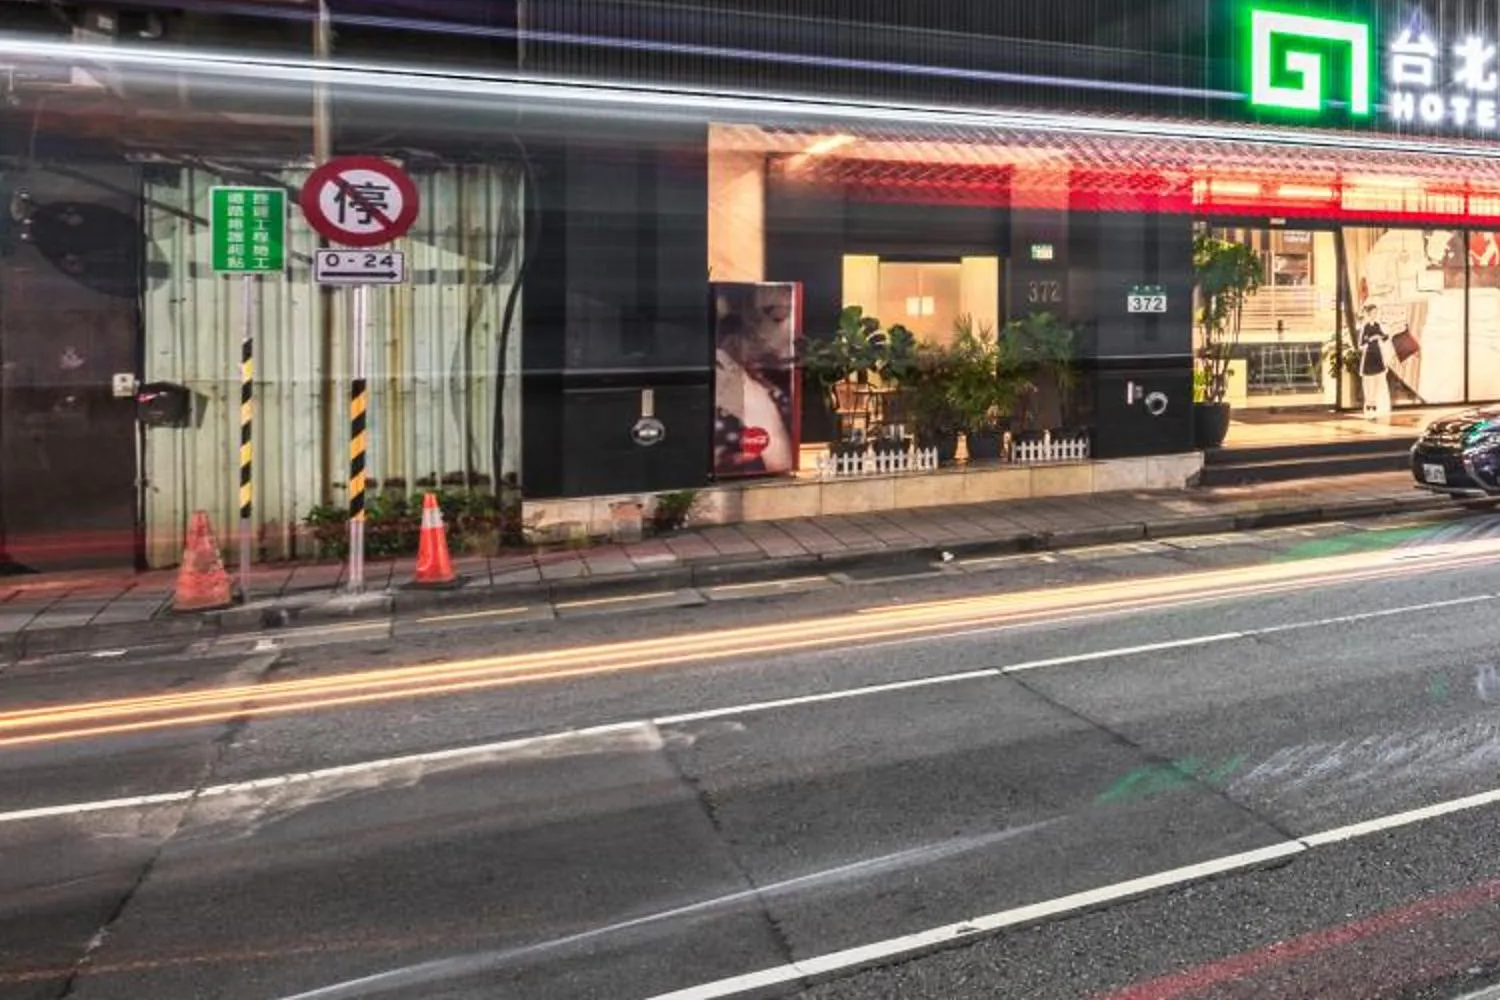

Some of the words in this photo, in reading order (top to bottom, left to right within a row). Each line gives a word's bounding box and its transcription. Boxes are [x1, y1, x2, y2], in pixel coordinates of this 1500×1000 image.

[333, 181, 391, 225] 停
[1029, 280, 1063, 303] 372
[1133, 297, 1163, 311] 372
